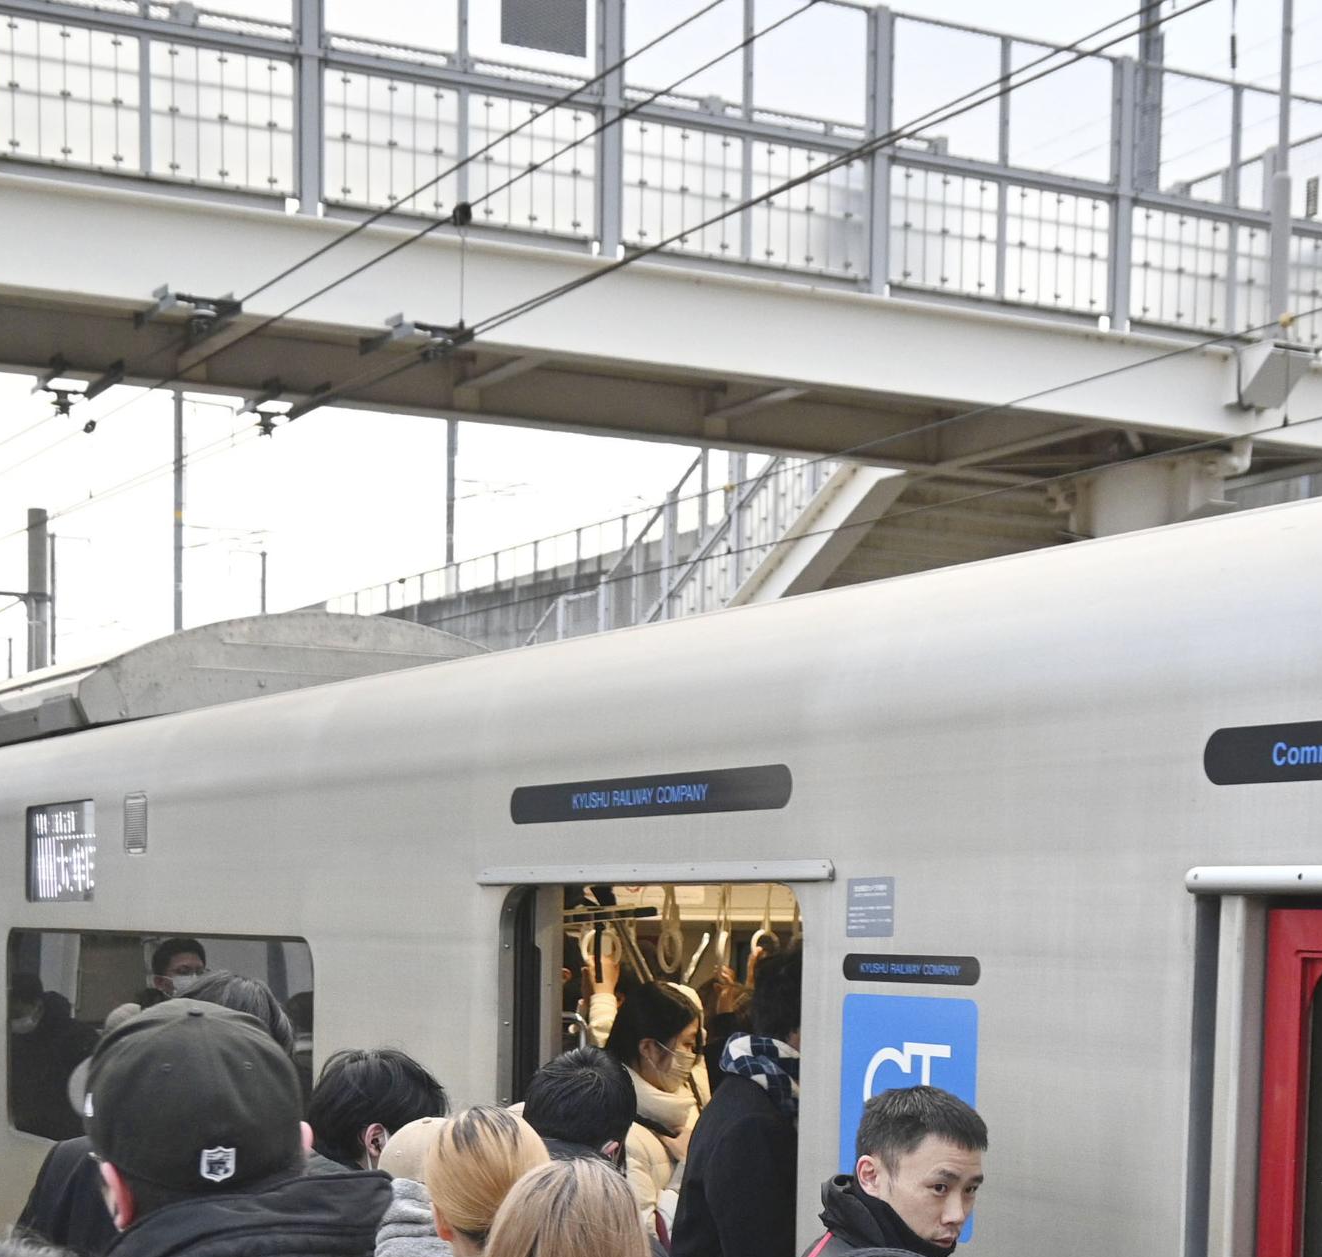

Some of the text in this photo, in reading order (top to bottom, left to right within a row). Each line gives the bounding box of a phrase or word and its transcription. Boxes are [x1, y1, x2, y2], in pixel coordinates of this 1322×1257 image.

[571, 783, 709, 810] KYUSHU RAILWAY COMPANY
[859, 962, 962, 976] KYUSHU RAILWAY COMPANY
